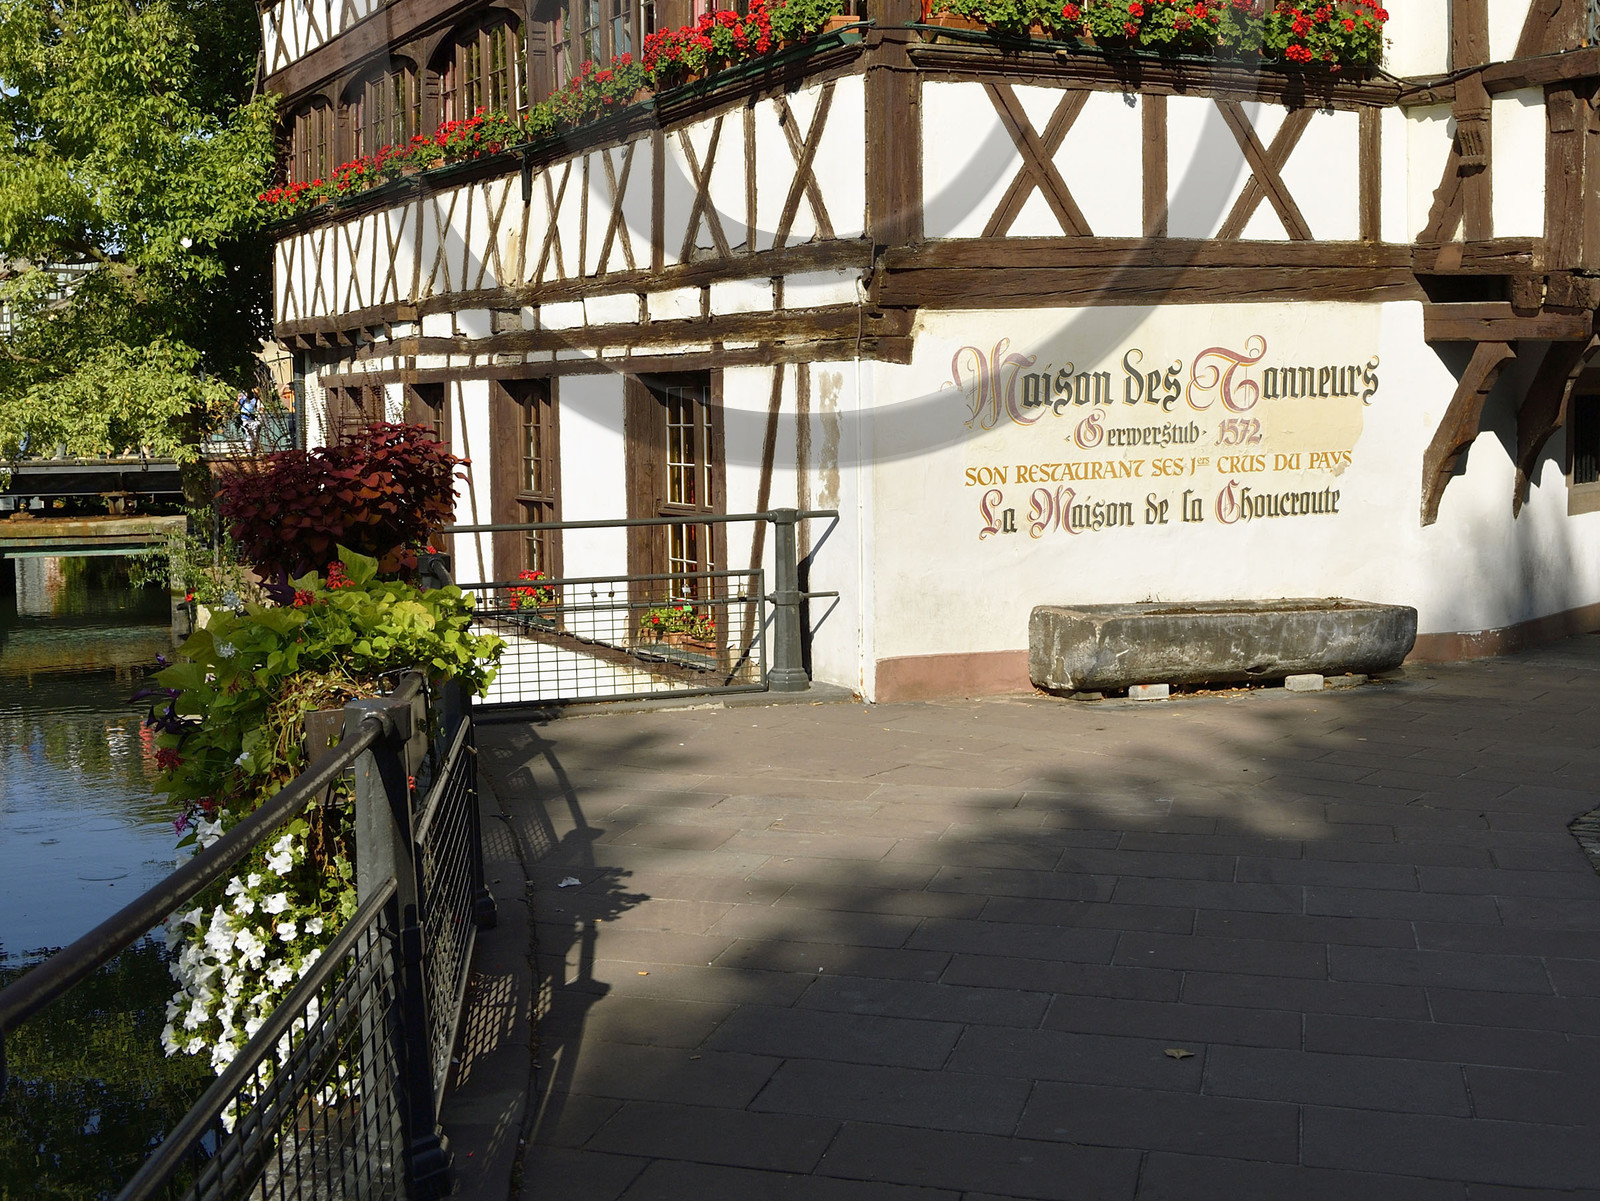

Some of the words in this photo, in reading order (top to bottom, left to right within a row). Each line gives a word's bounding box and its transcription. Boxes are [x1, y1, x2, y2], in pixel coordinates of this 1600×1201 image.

[951, 337, 1114, 430] Maison
[1121, 348, 1182, 413] des
[1186, 334, 1380, 414] Tanneurs
[1214, 417, 1263, 447] 1572
[965, 465, 1009, 487] SON
[1014, 459, 1146, 484] RESTAURANT
[1151, 457, 1184, 477] SES
[1216, 453, 1266, 474] CRUS
[1273, 452, 1301, 471] DU
[1308, 449, 1353, 473] PAYS
[979, 488, 1018, 540] La
[1027, 485, 1135, 540] Maison
[1144, 492, 1169, 525] de
[1182, 488, 1205, 523] la
[1215, 478, 1341, 525] Choucroute
